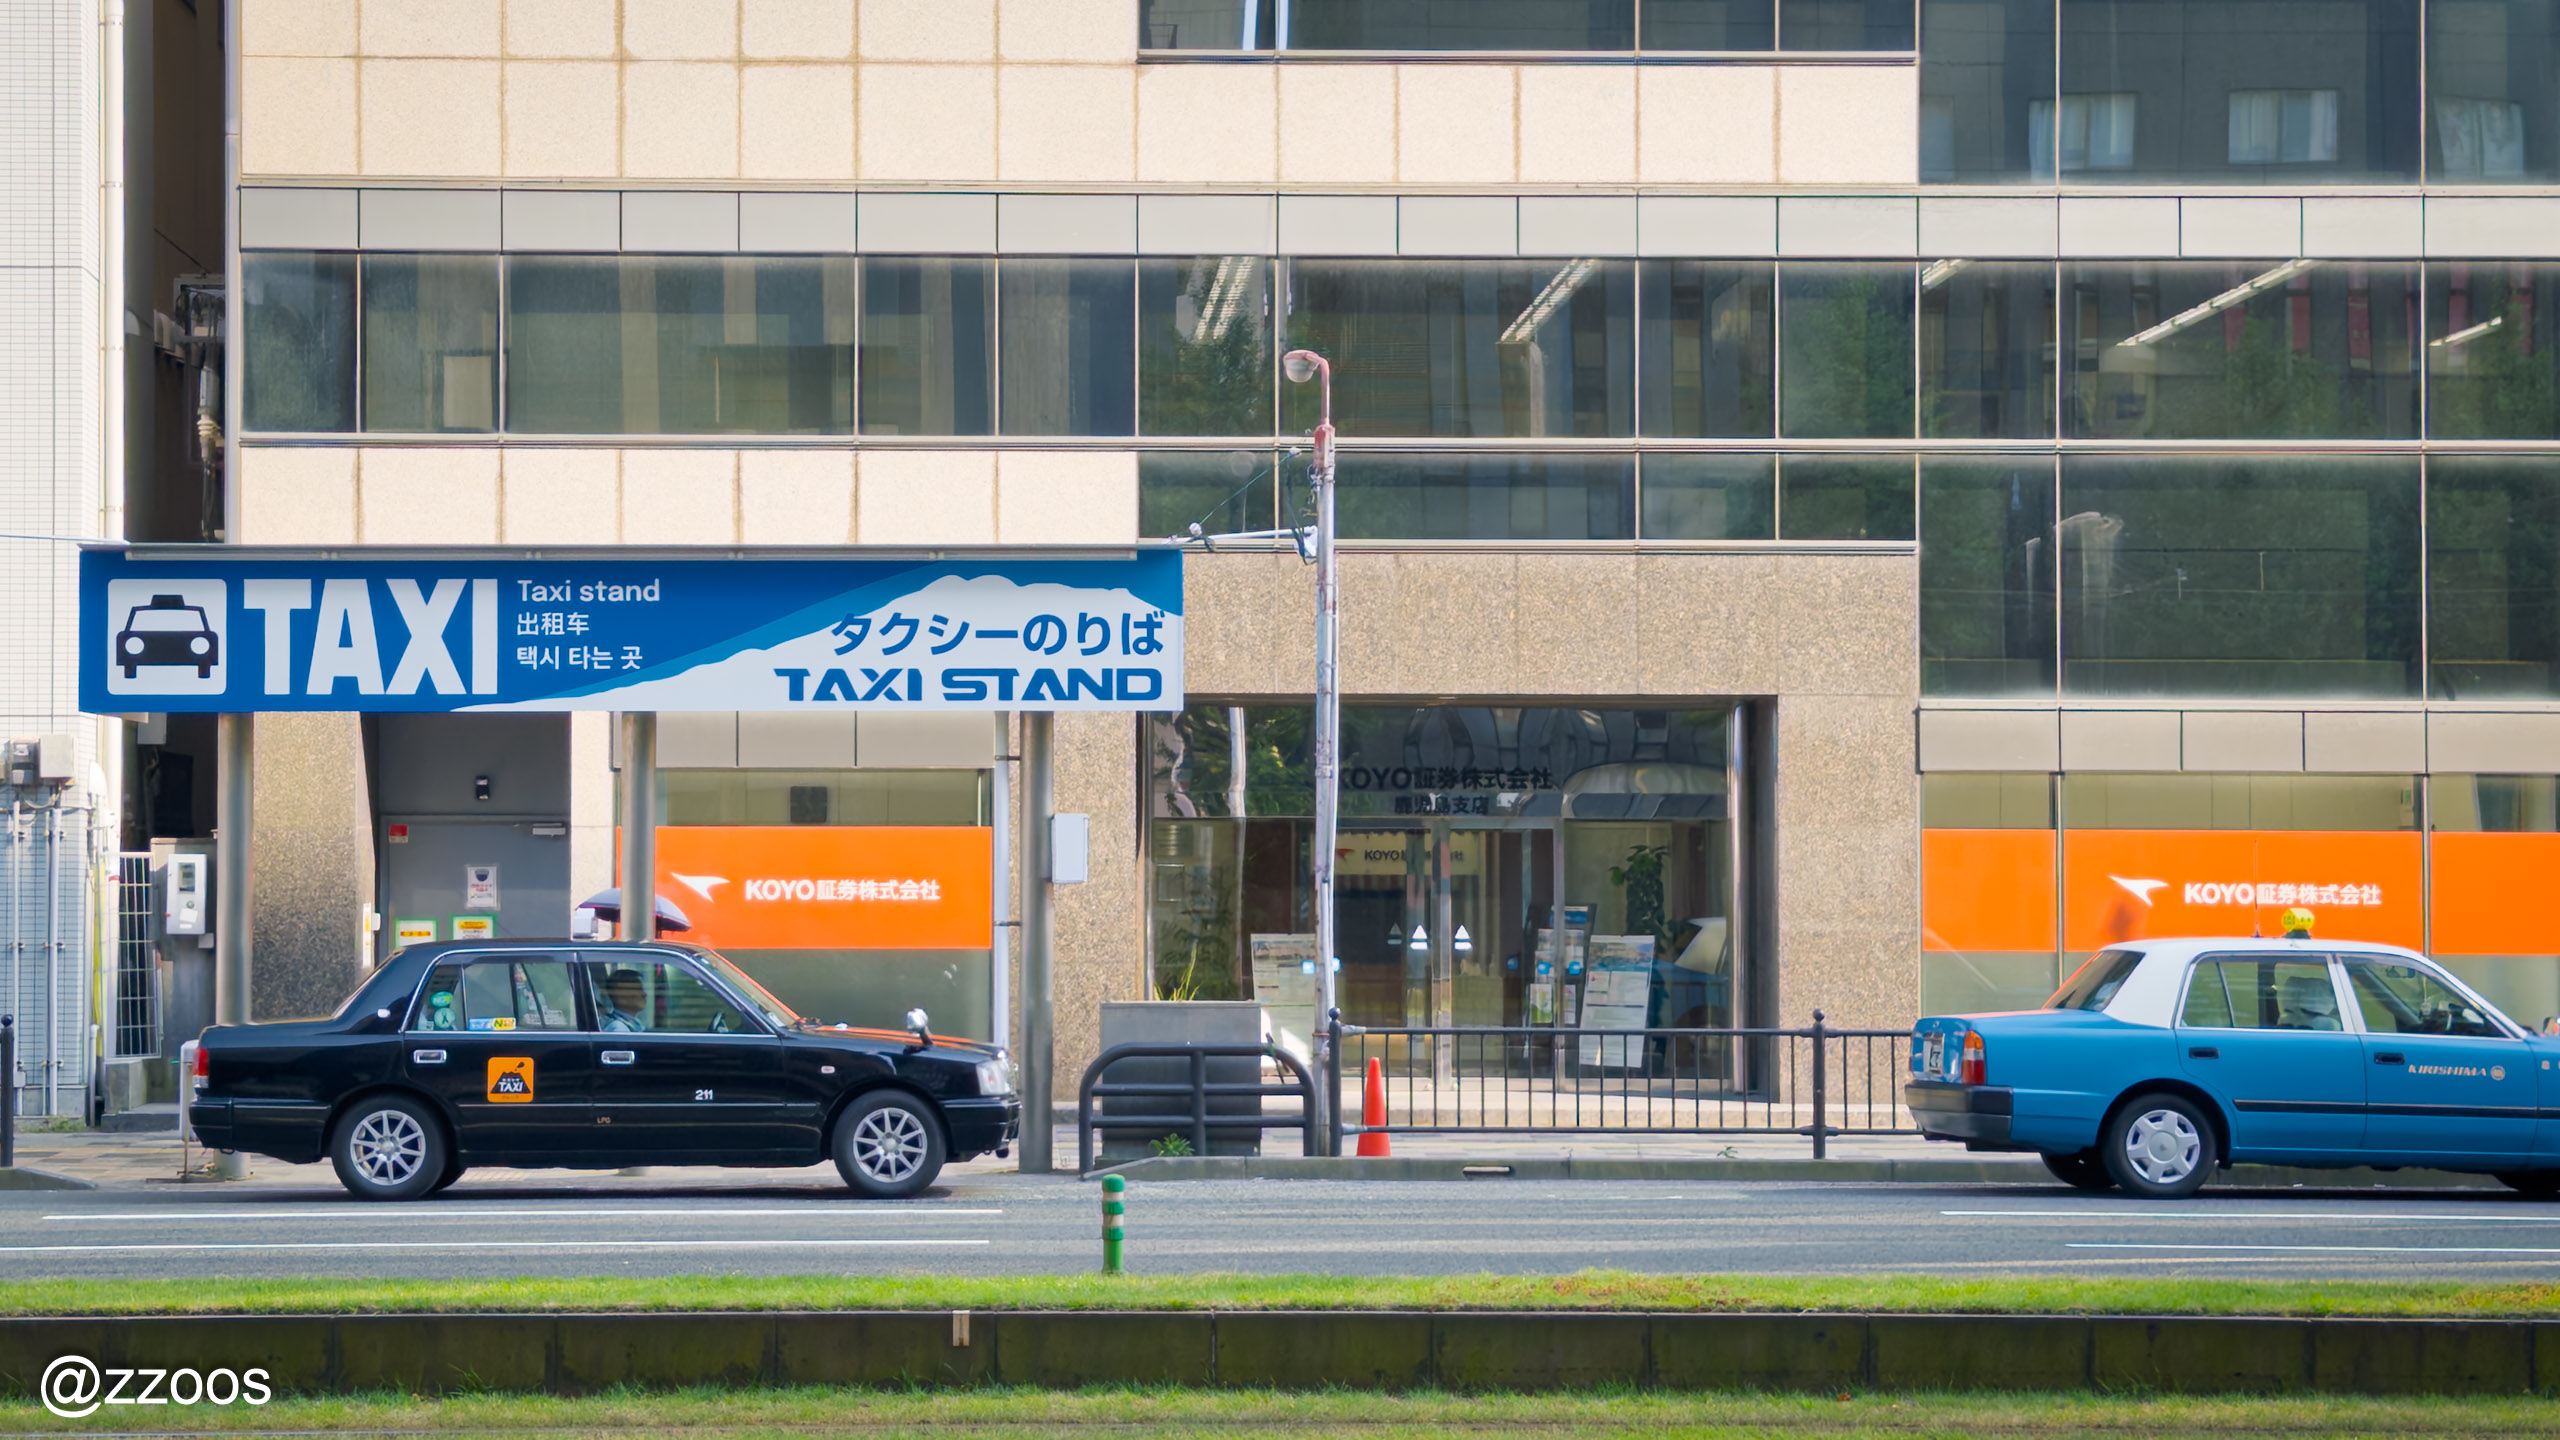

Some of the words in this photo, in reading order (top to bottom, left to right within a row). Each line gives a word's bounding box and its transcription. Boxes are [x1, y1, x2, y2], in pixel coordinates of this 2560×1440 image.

[517, 579, 572, 602] Taxi
[579, 578, 661, 602] stand
[516, 611, 590, 636] 出租车
[831, 610, 1166, 656] タクシーのりば
[243, 578, 498, 695] TAXI
[516, 645, 560, 670] 택시
[568, 645, 614, 670] 타는
[620, 645, 643, 670] 곳
[773, 668, 922, 702] TAXI
[941, 668, 1163, 702] STAND
[498, 1081, 523, 1092] TAXI
[695, 1089, 713, 1100] 211
